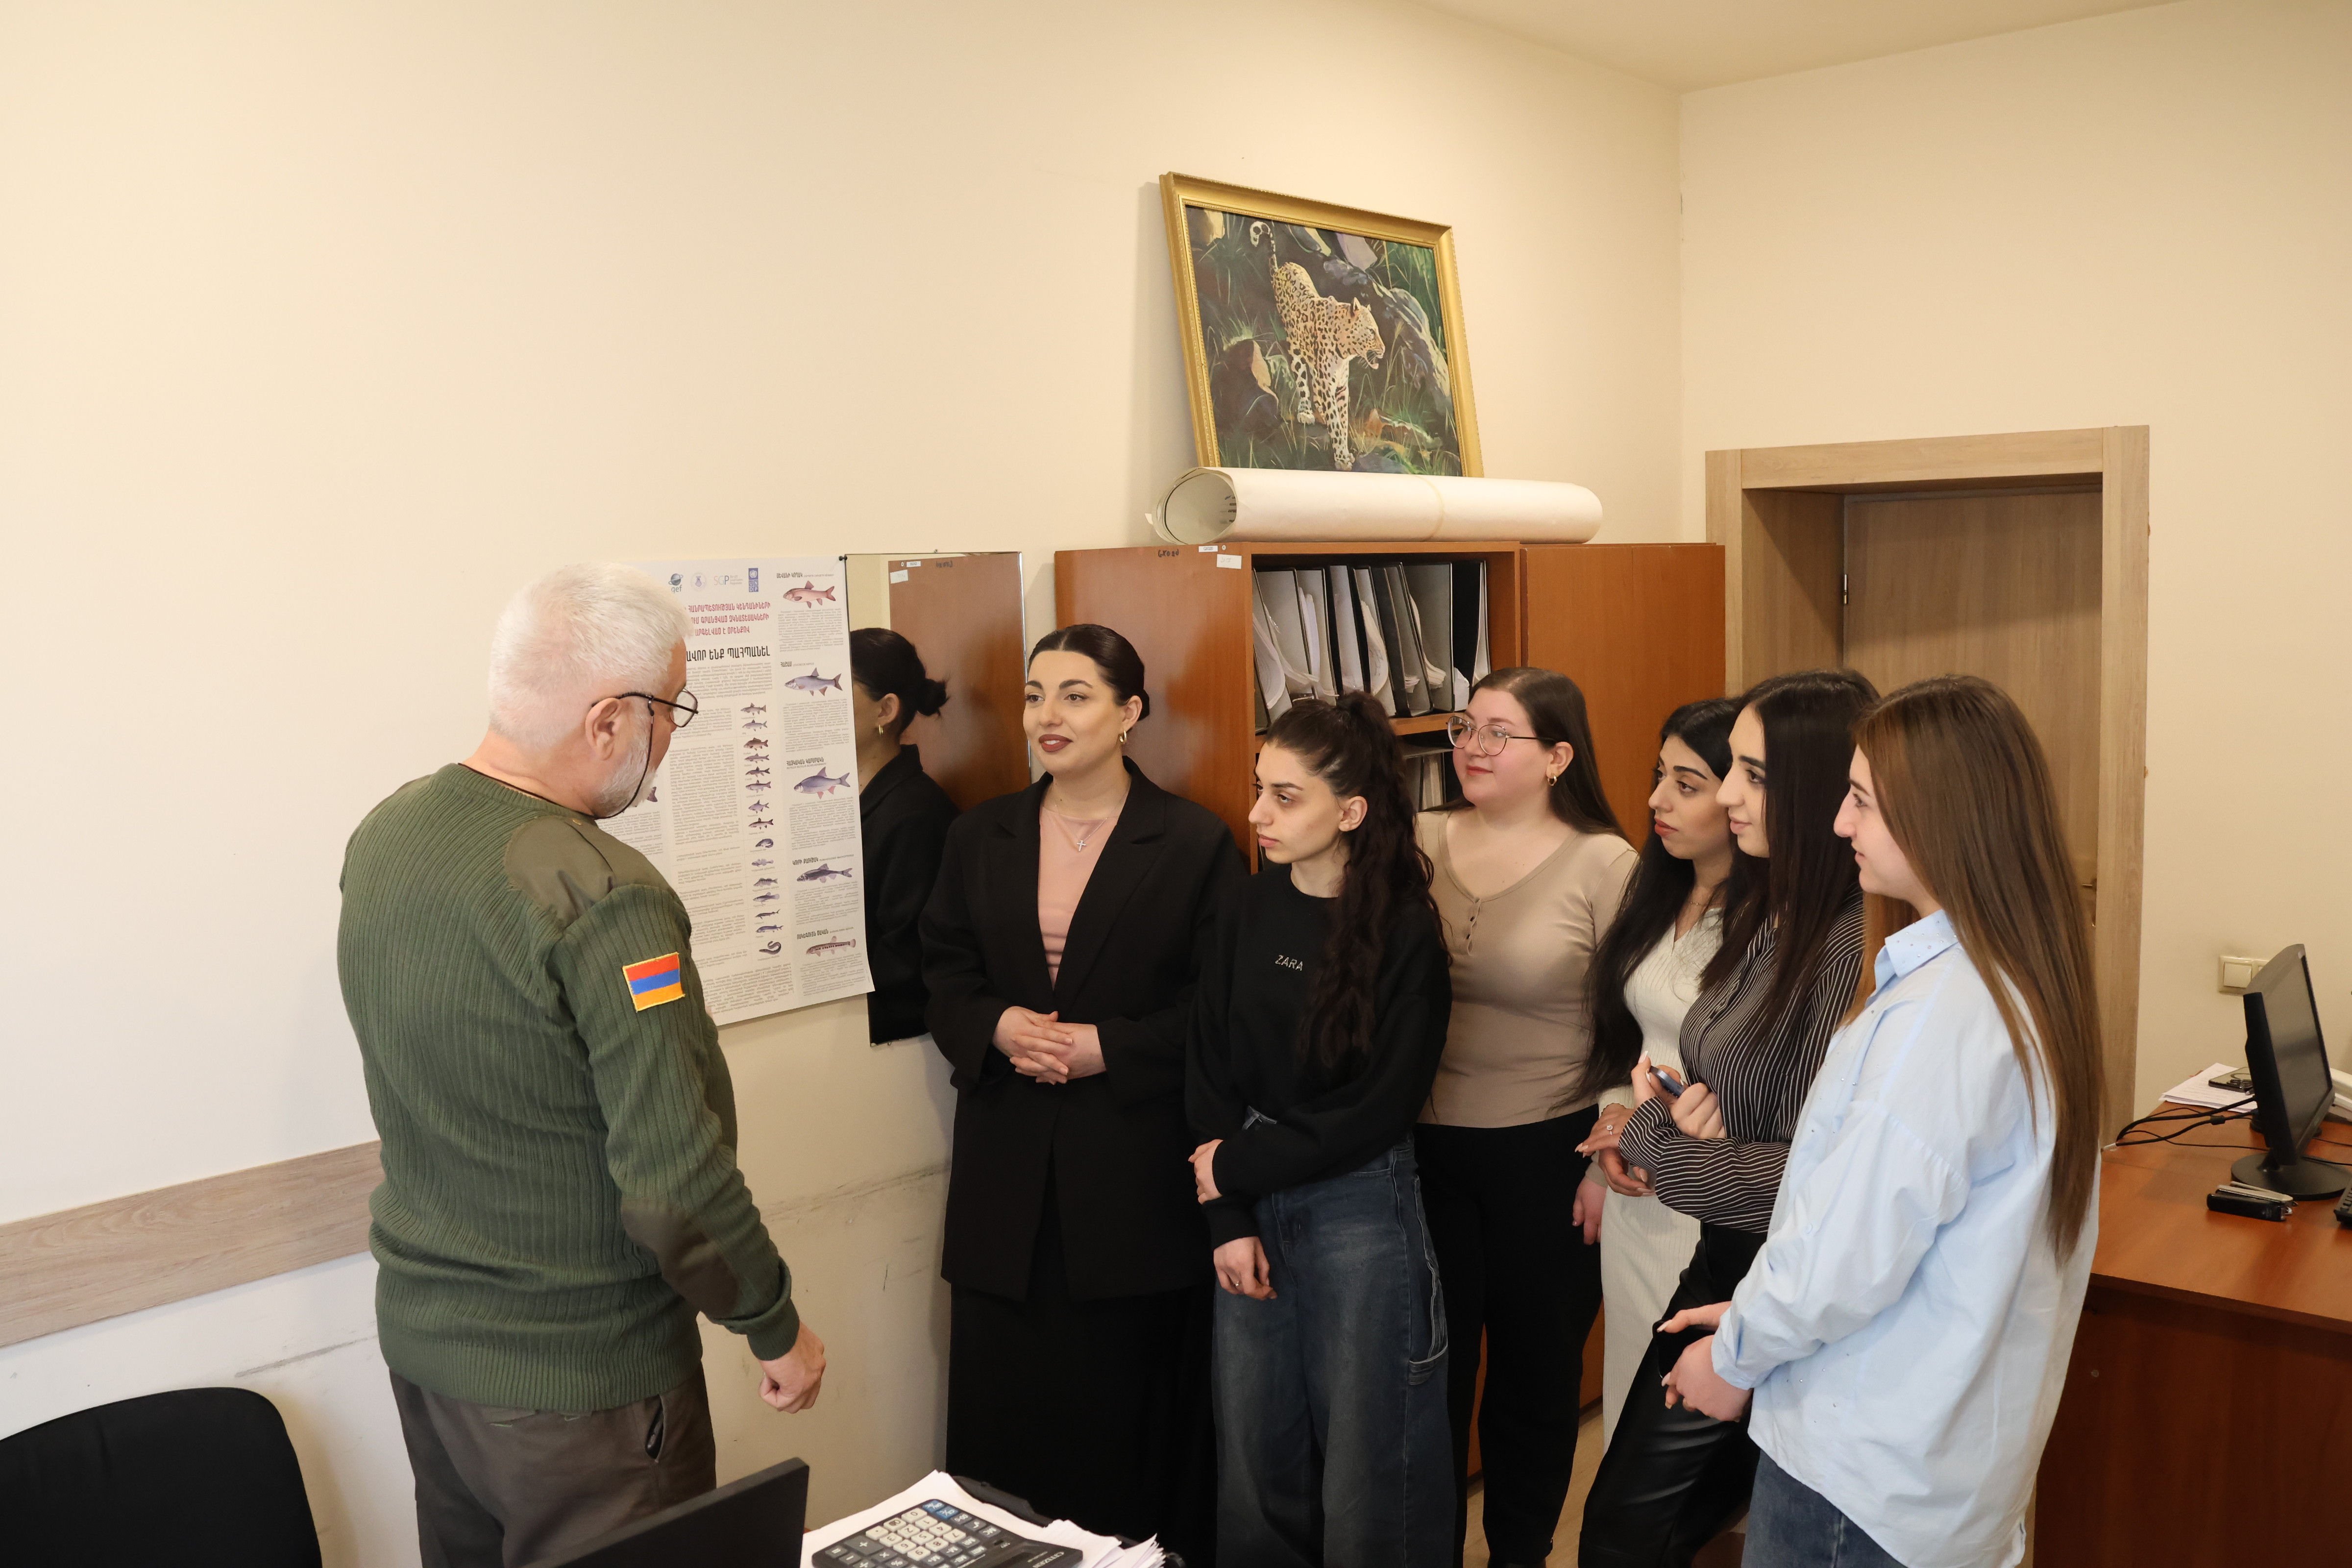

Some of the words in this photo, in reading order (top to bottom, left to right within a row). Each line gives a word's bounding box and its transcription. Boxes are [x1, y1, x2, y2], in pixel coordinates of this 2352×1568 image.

[714, 575, 729, 585] SGP
[671, 585, 682, 593] gef
[688, 603, 735, 612] ՀԱՆՐԱՊԵՏՈՒԹՅԱՆ
[736, 602, 770, 610] ԿԵՆԴԱՆԻՆԵՐԻ
[701, 615, 728, 624] ԳՐԱՆՑՎԱԾ
[729, 613, 769, 622] ՁԿՆԱՏԵՍԱԿՆԵՐԻ
[686, 650, 706, 662] ԱՎՈՐ
[710, 649, 724, 660] ԵՆՔ
[728, 646, 770, 659] ՊԱՀՊԱՆԵԼ
[1275, 955, 1303, 971] ZARA
